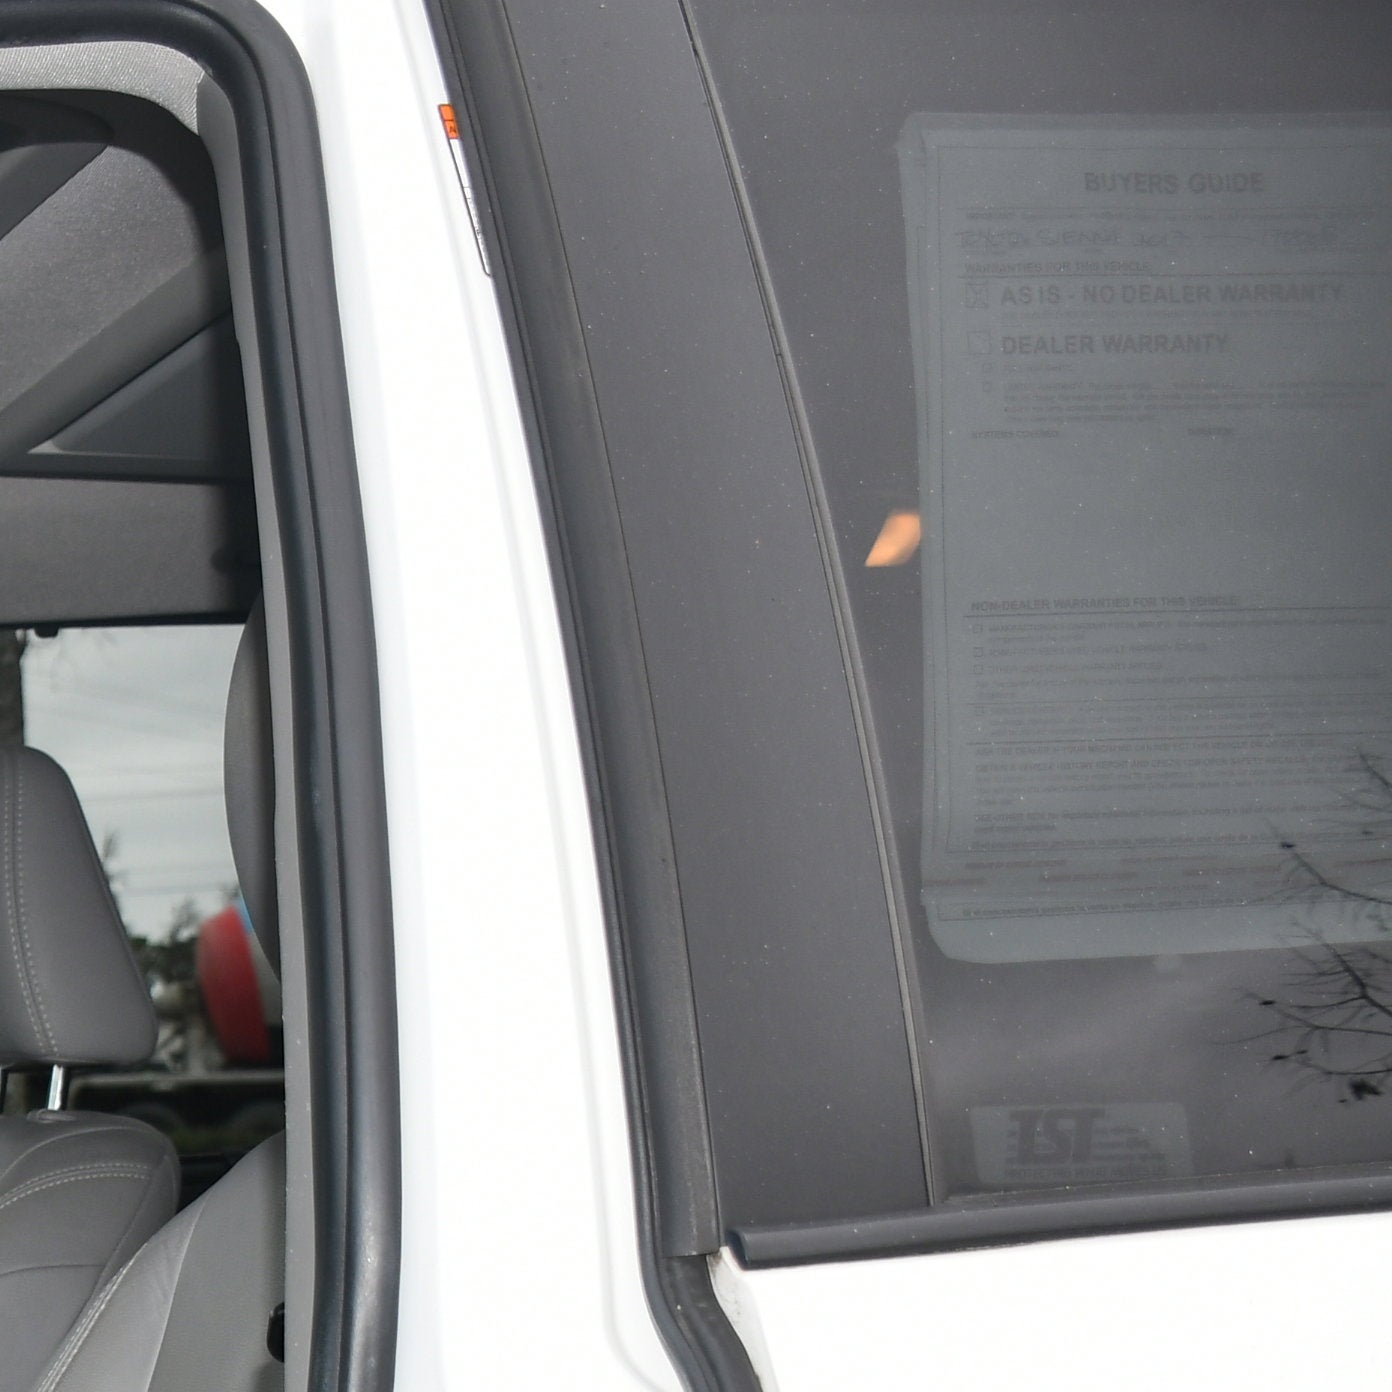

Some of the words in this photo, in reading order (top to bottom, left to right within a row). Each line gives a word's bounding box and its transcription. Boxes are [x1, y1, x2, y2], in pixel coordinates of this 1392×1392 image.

[1084, 171, 1180, 194] BUYERS
[1189, 171, 1265, 193] GUIDE
[1000, 286, 1031, 306] AS
[1037, 286, 1061, 305] IS
[1082, 286, 1115, 304] NO
[1122, 285, 1211, 304] DEALER
[1218, 283, 1345, 303] WARRANTY
[1001, 335, 1095, 355] DEALER
[1101, 333, 1230, 354] WARRANTY
